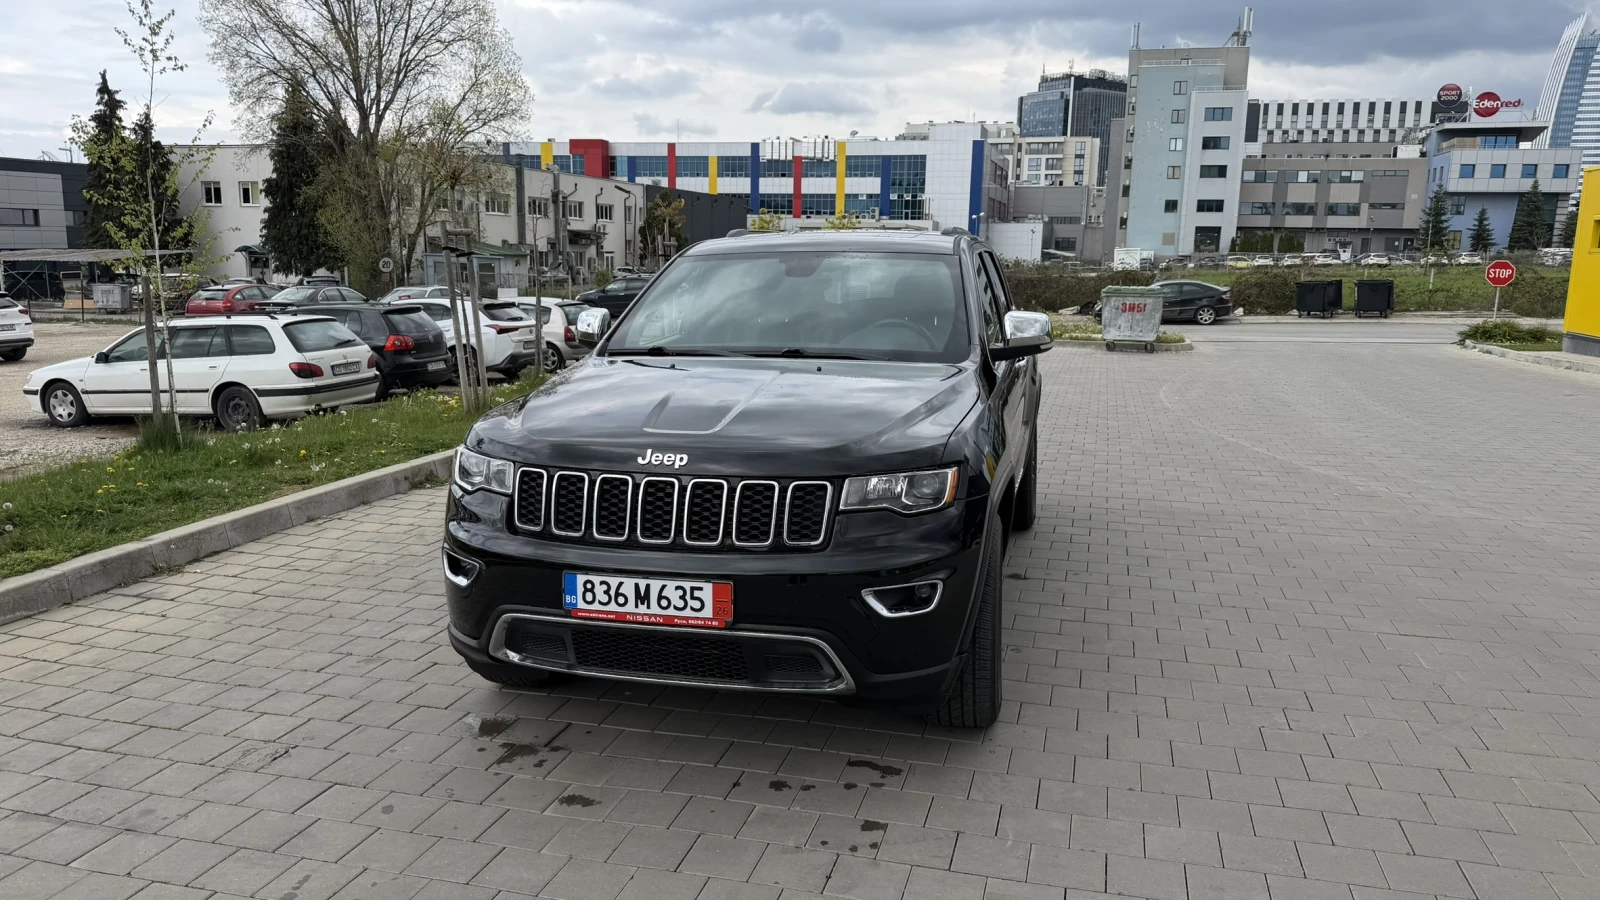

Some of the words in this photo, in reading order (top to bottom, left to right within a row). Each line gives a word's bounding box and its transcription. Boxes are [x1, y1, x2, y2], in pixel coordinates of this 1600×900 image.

[1473, 98, 1522, 109] Edenred
[381, 260, 391, 269] 20
[1488, 268, 1513, 279] STOP
[637, 448, 689, 469] Jeep
[565, 594, 577, 604] BG
[581, 579, 629, 608] 836
[633, 582, 651, 610] M
[656, 584, 706, 613] 635
[716, 605, 729, 615] 26
[626, 614, 664, 623] NISSAN
